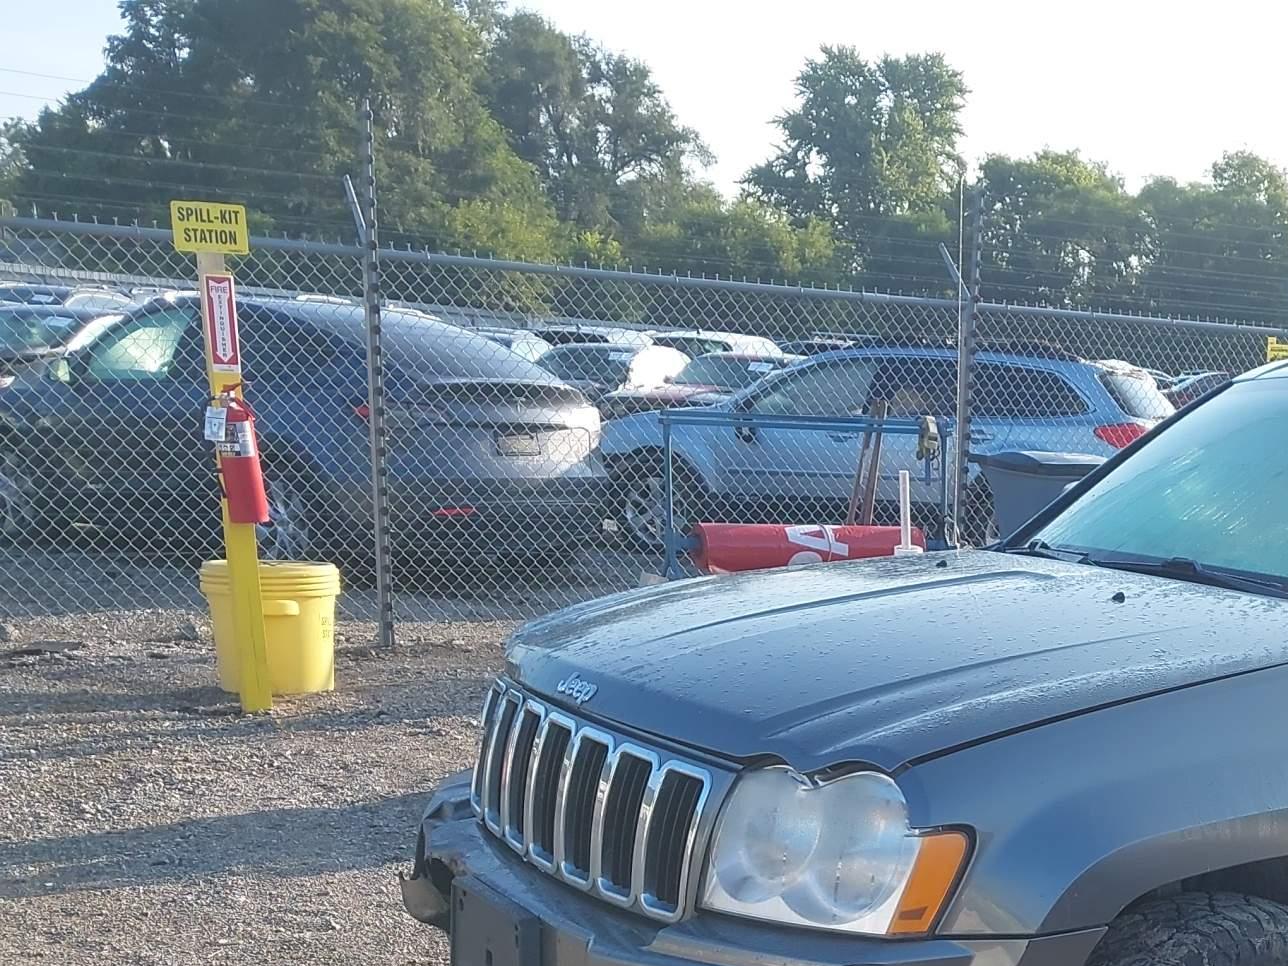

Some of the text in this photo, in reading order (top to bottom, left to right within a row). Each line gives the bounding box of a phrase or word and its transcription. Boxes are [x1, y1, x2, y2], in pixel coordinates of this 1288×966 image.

[177, 206, 239, 225] SPILL-KIT
[183, 227, 237, 245] STATION
[210, 285, 228, 294] FIRE
[557, 671, 597, 704] Jeep
